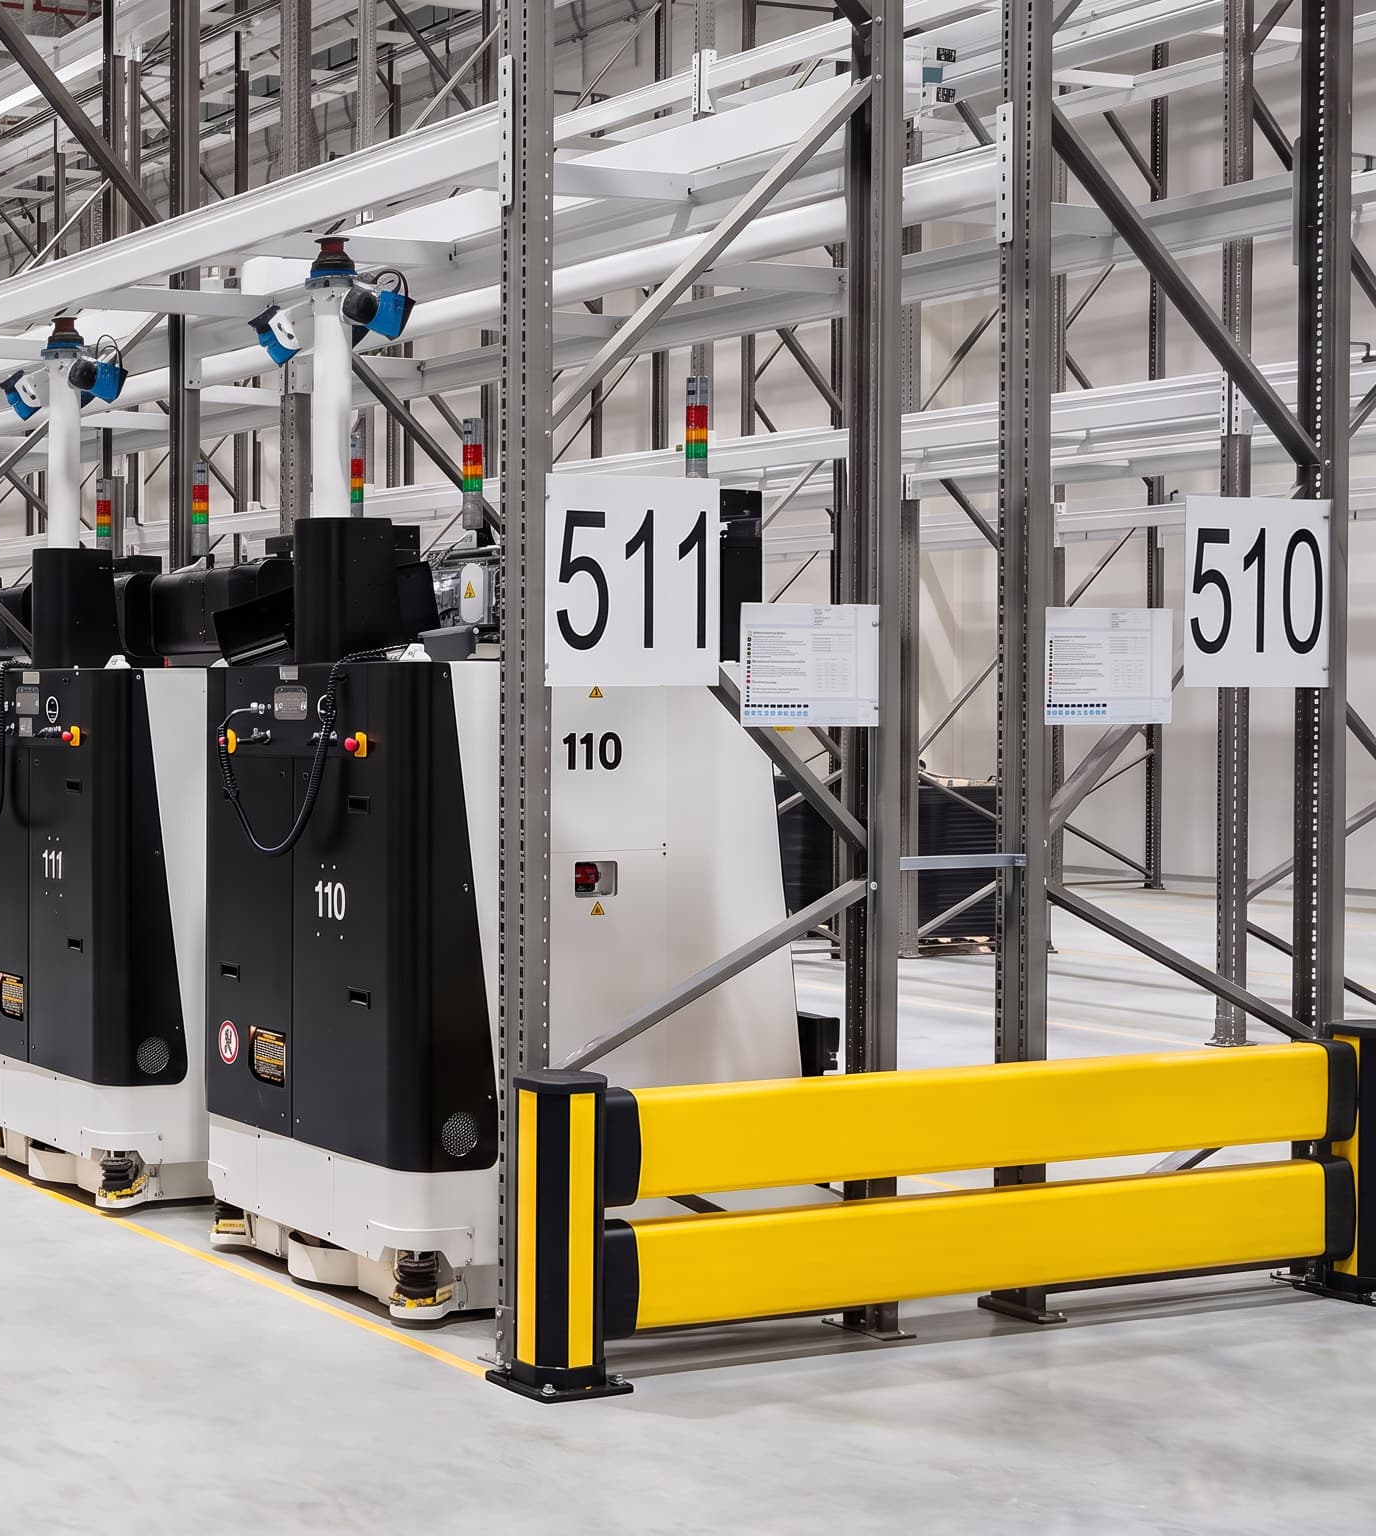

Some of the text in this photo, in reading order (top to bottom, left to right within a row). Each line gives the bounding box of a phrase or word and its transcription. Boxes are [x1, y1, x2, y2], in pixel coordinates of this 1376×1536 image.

[556, 509, 707, 651] 511
[1190, 527, 1323, 655] 510
[562, 731, 622, 771] 110
[41, 849, 63, 880] 111
[314, 880, 346, 921] 110
